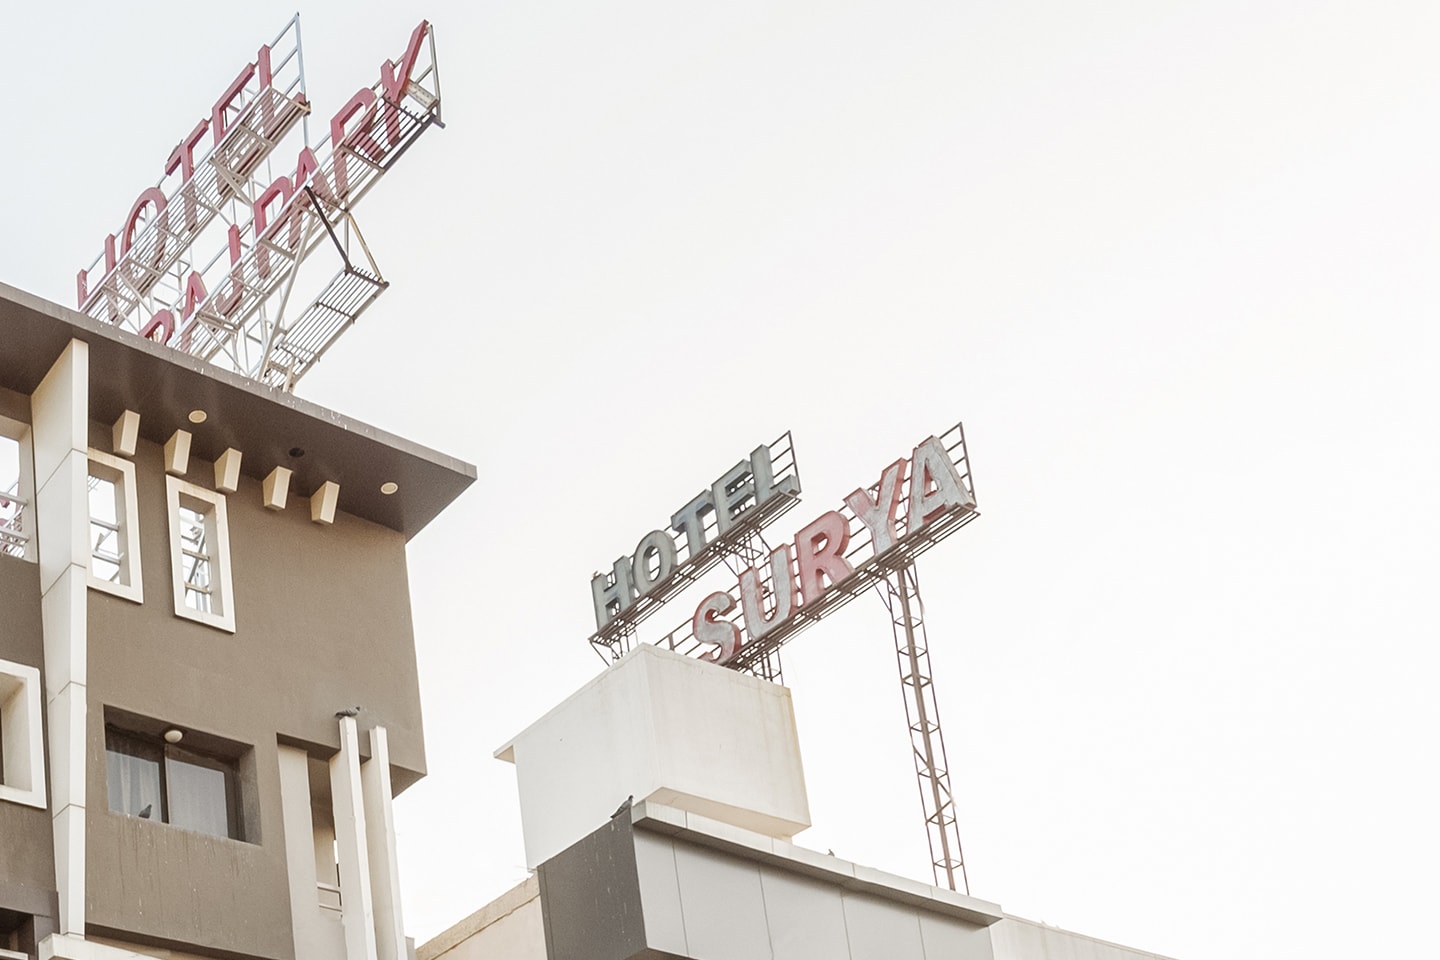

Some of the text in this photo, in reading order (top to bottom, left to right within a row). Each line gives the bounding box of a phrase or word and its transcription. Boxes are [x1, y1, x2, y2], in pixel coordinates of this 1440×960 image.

[77, 44, 308, 322] HOTEL
[591, 443, 799, 629] HOTEL
[693, 434, 977, 664] SURYA
